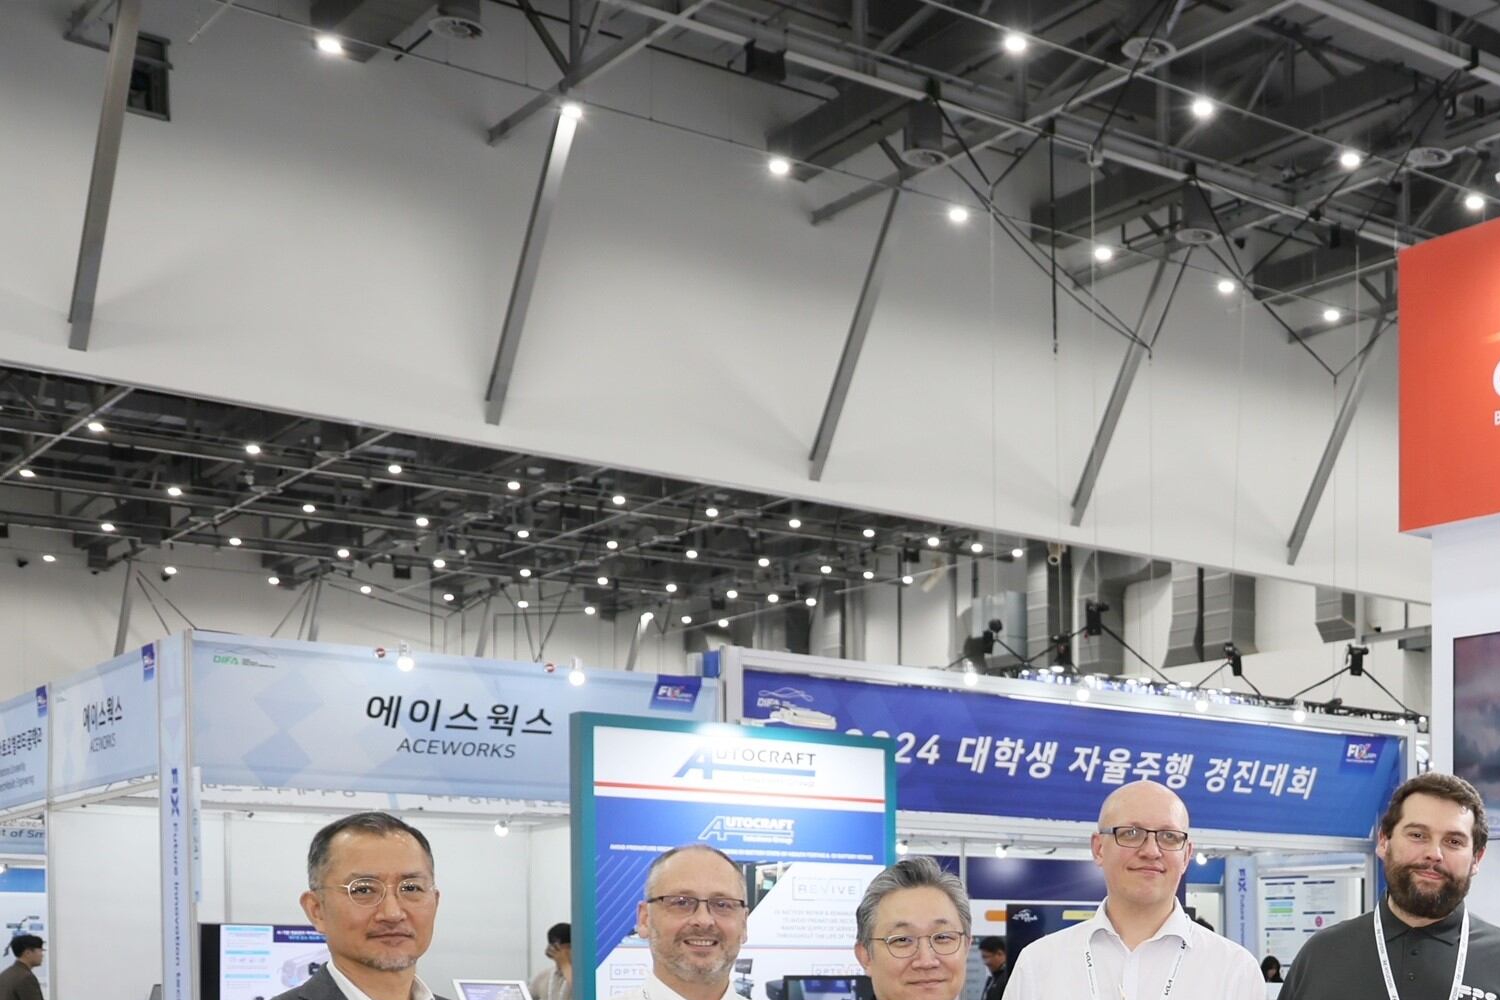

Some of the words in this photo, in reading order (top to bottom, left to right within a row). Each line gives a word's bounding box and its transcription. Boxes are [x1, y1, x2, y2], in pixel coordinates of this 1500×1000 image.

[83, 696, 122, 731] 에이스웍스
[366, 695, 553, 736] 에이스웍스
[397, 737, 516, 759] ACEWORKS
[956, 736, 1060, 777] 대학생
[1068, 745, 1195, 789] 자율주행
[1204, 757, 1319, 800] 경진대회
[698, 816, 795, 841] AUTOCRAFT
[798, 880, 857, 895] REVIVE
[1237, 868, 1247, 892] FIX
